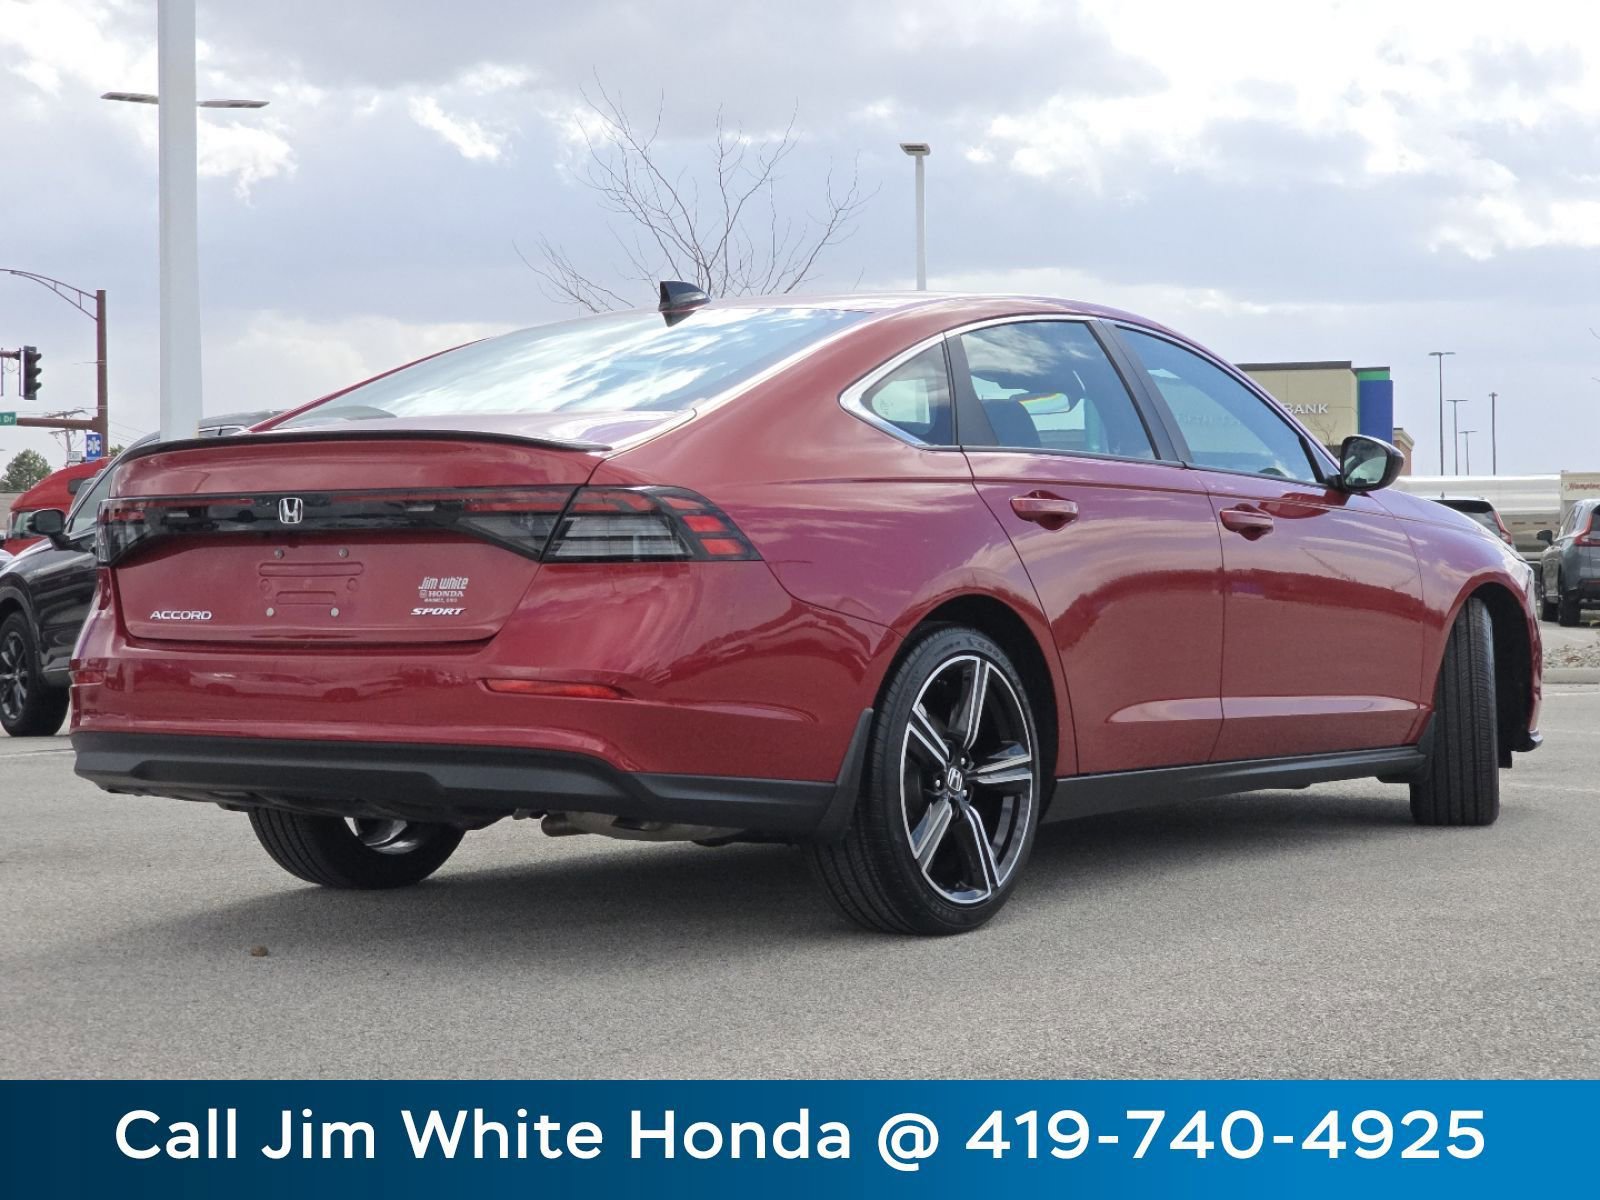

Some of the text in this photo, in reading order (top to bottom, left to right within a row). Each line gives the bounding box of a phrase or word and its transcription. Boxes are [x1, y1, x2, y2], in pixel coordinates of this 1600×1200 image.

[1281, 402, 1329, 415] BANK
[3, 415, 14, 424] Dr
[428, 590, 465, 598] HONDA
[149, 610, 213, 621] ACCORD
[410, 607, 467, 616] SPORT
